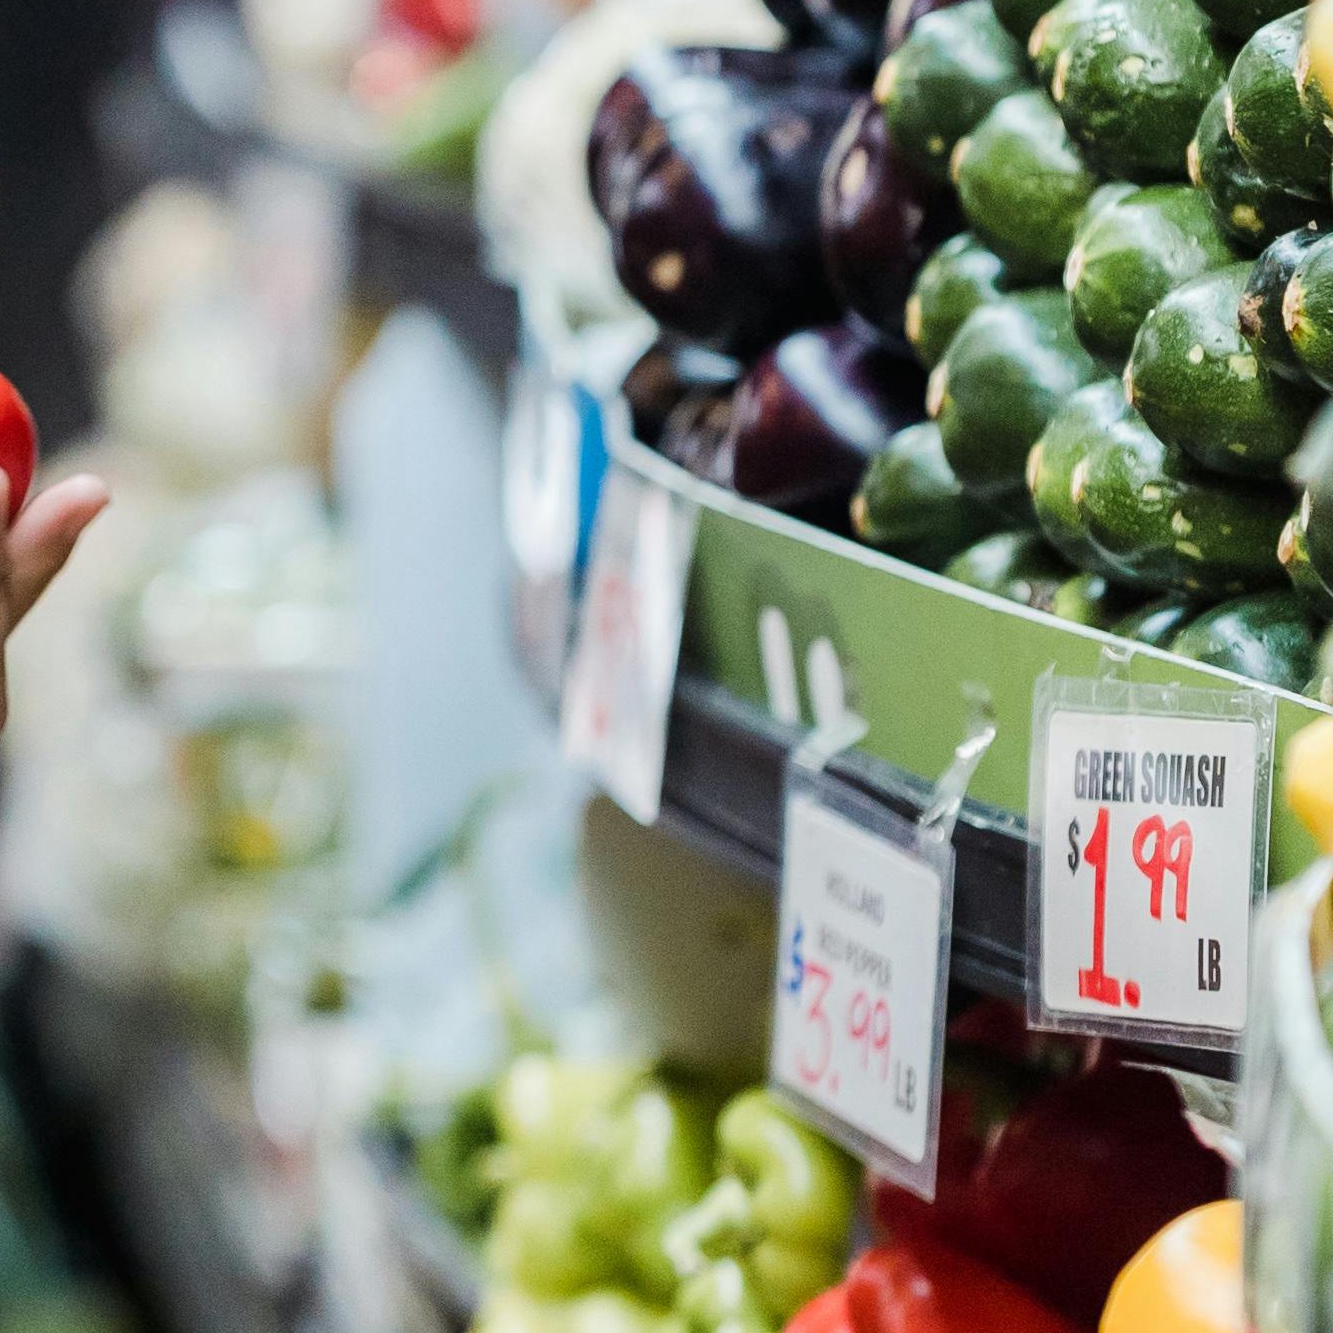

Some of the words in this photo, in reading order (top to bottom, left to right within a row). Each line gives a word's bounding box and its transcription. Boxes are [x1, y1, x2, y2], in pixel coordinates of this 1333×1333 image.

[1074, 748, 1136, 803] GREEN
[1198, 938, 1221, 992] LB
[894, 1058, 918, 1114] LB
